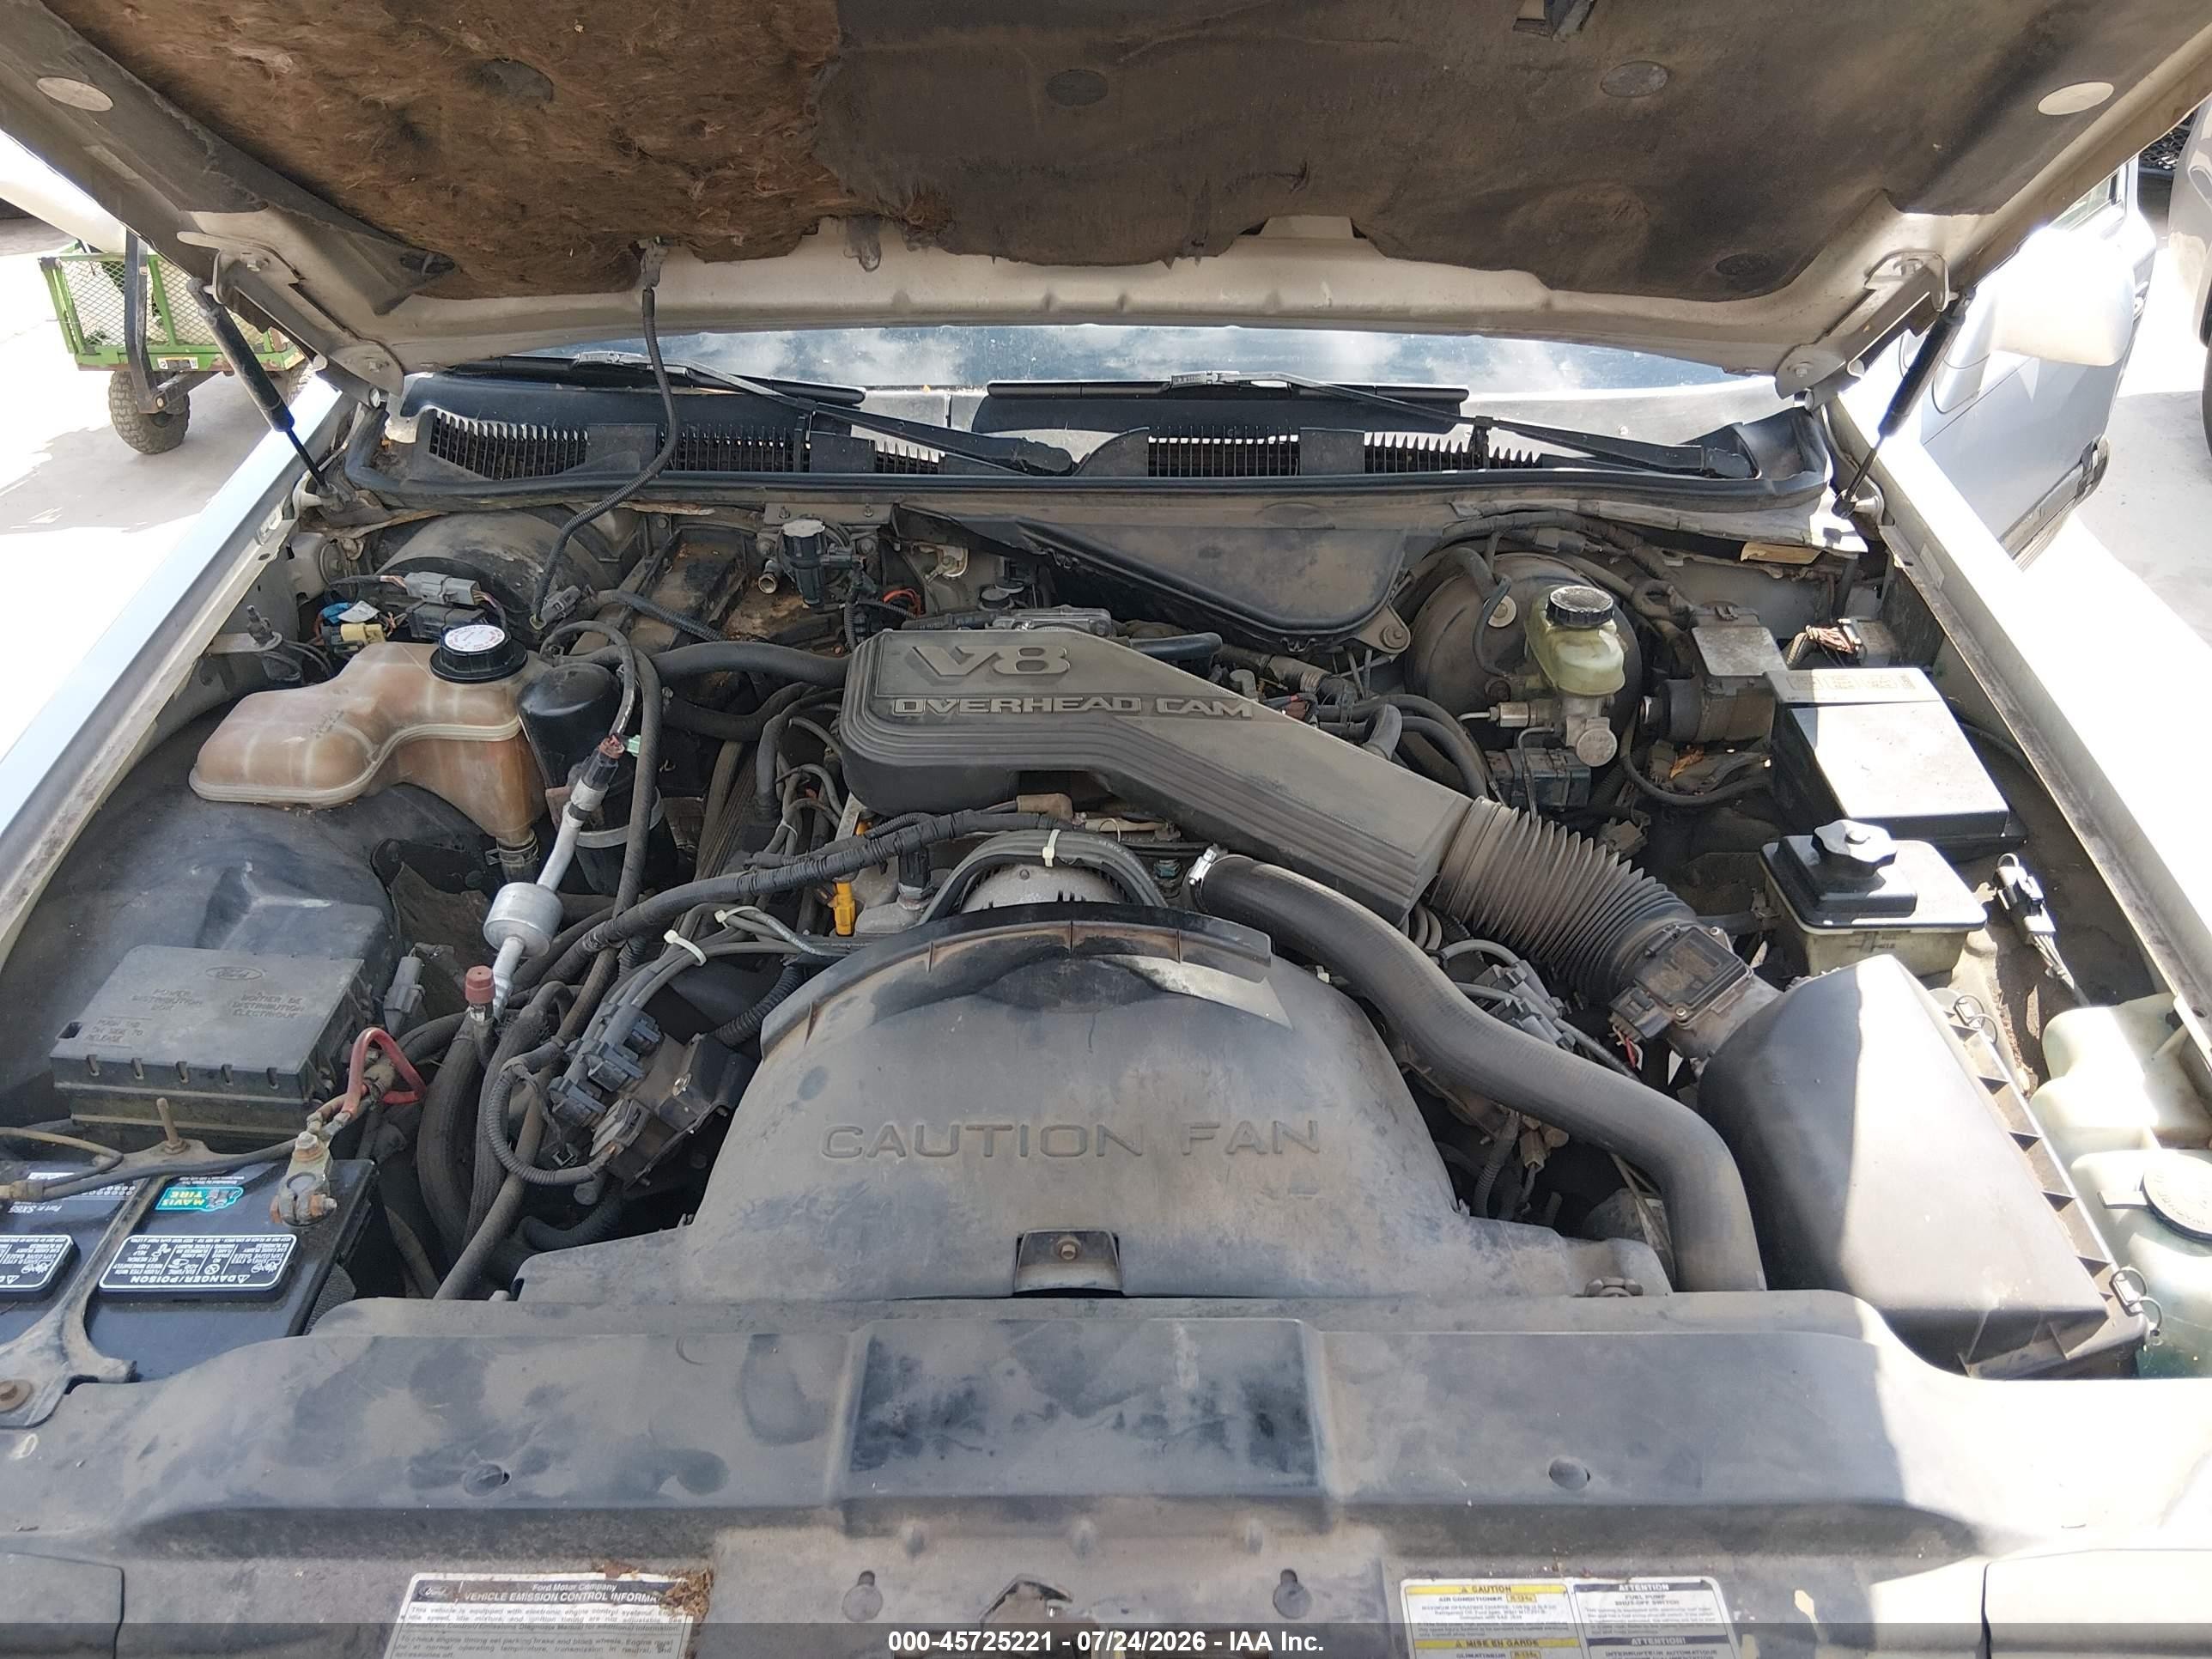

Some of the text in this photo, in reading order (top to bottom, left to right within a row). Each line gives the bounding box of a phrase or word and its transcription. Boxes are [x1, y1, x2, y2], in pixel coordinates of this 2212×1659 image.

[912, 645, 1070, 677] V8
[893, 696, 1253, 719] OVERHEAD CAM
[821, 1120, 1320, 1158] CAUTION FAN
[131, 1274, 237, 1283] DANGER/POISON
[580, 1584, 617, 1593] Company
[1471, 1585, 1512, 1594] CAUTION
[464, 1592, 660, 1603] VEHICLE EMISSION CONTROL INFORMA
[1465, 1639, 1488, 1648] MISE
